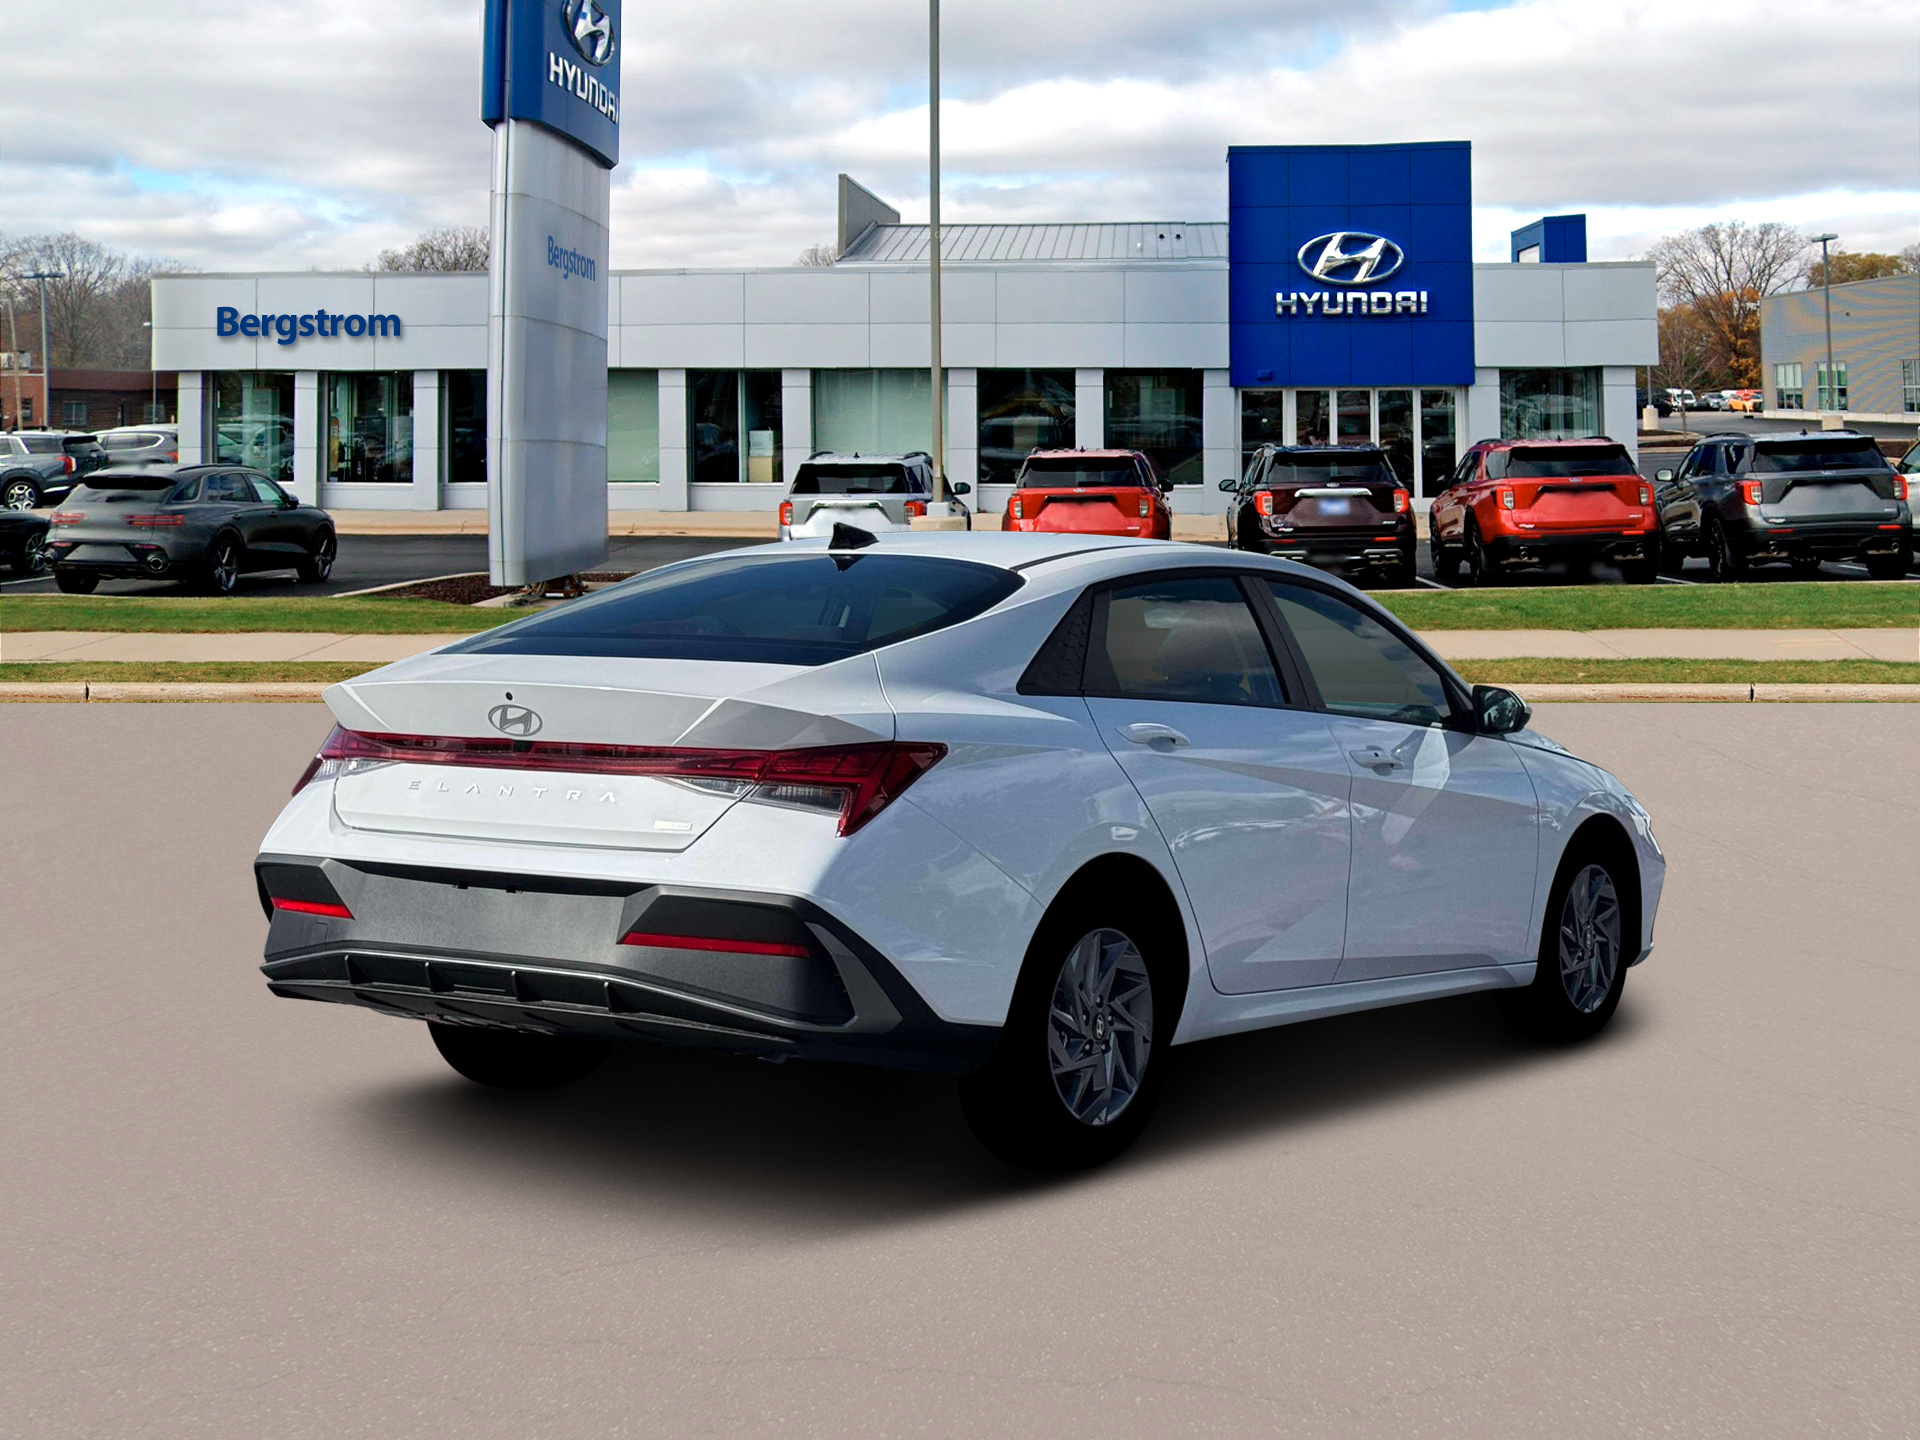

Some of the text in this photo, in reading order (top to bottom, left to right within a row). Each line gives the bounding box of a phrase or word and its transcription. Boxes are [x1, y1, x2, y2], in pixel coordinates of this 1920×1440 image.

[549, 52, 619, 124] HYUNDAI
[547, 235, 596, 282] Bergstrom
[1275, 291, 1428, 315] HYUNDAI
[216, 306, 402, 346] Bergstrom
[407, 780, 618, 804] ELANTRA
